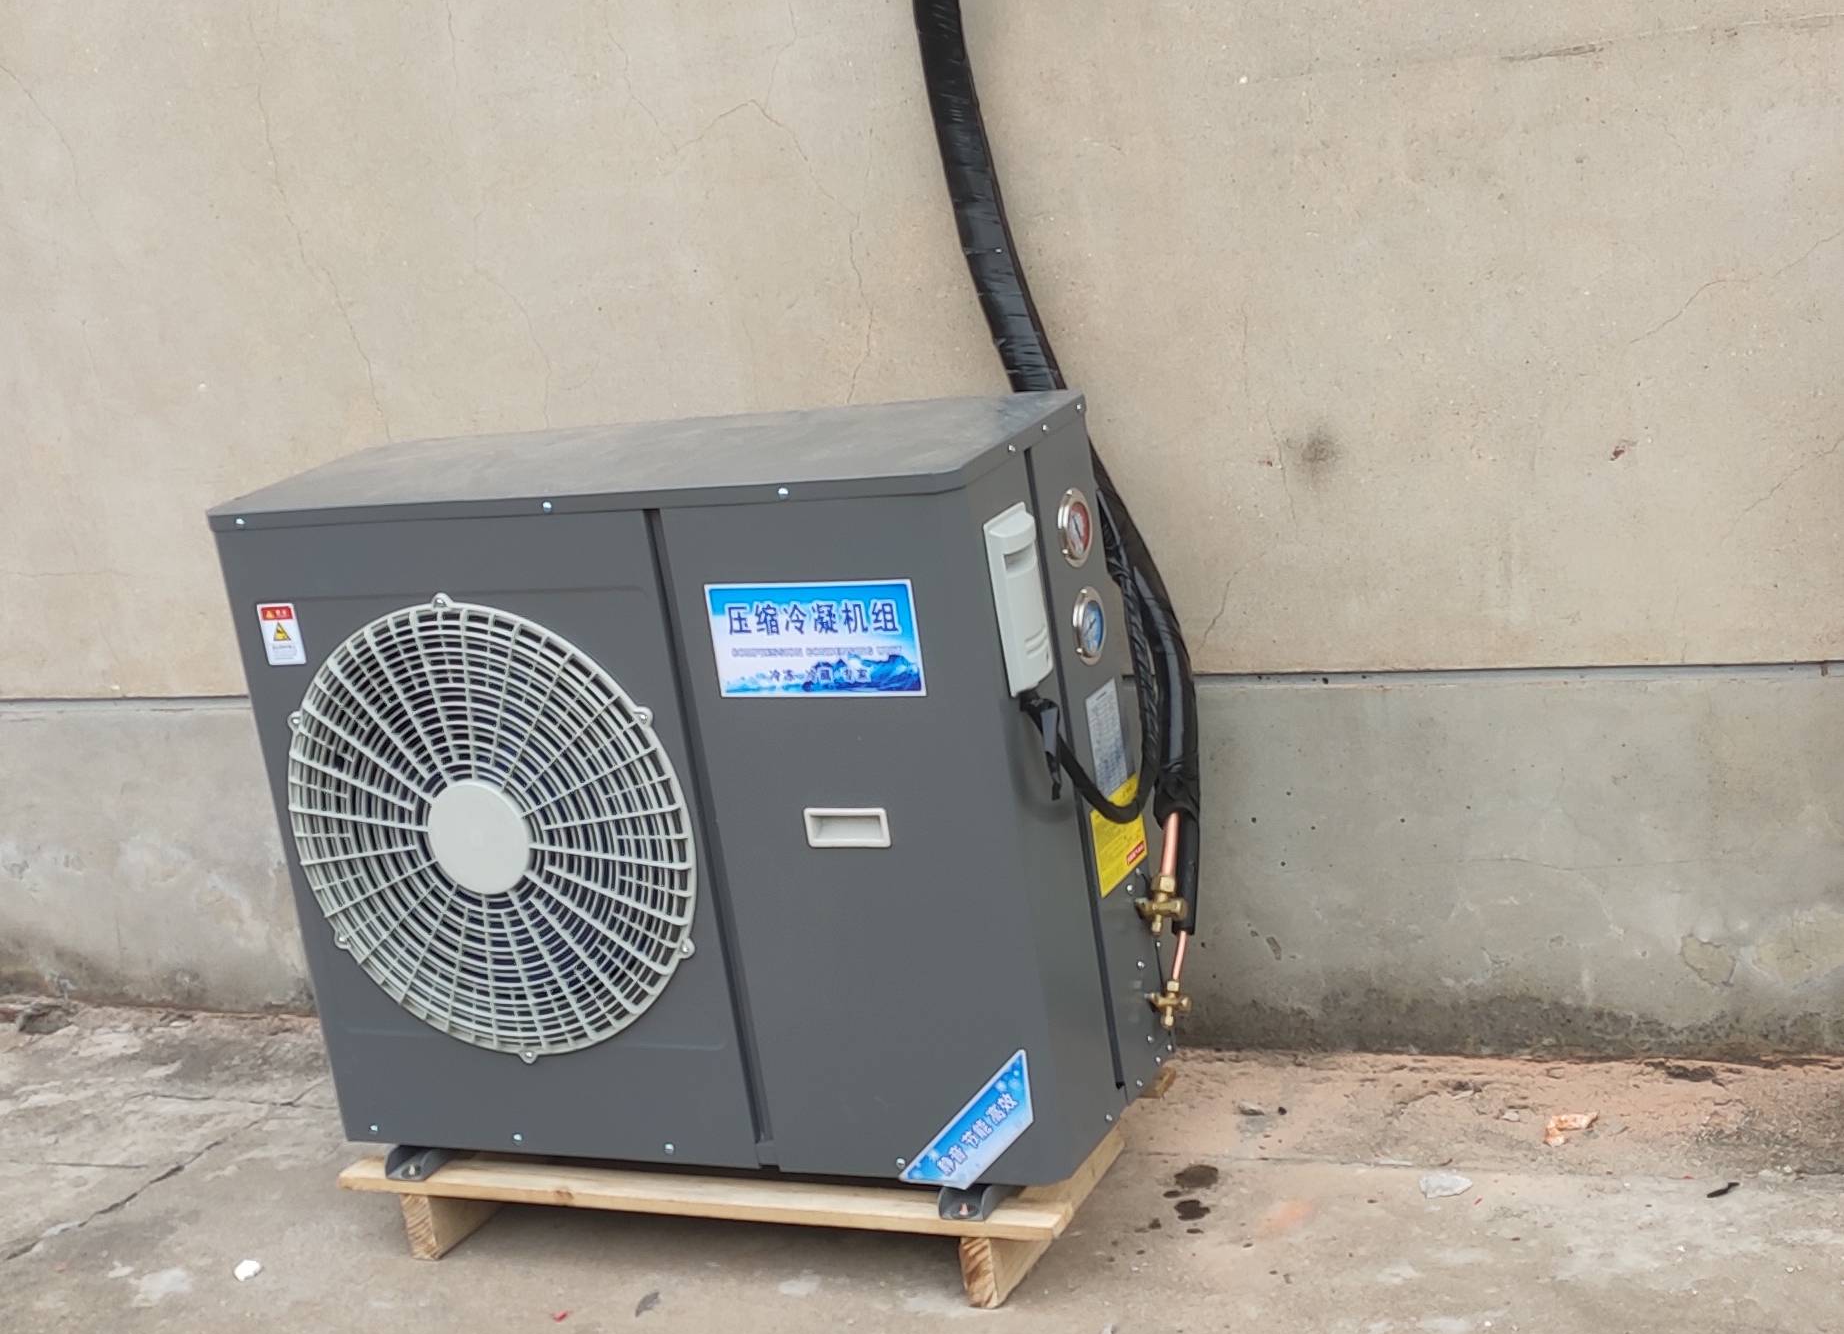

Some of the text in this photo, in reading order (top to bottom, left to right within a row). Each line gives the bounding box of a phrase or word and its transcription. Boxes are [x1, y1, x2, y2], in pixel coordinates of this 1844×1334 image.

[728, 602, 898, 635] 压缩冷凝机组
[961, 1119, 992, 1149] 节能
[985, 1093, 1018, 1125] 高效
